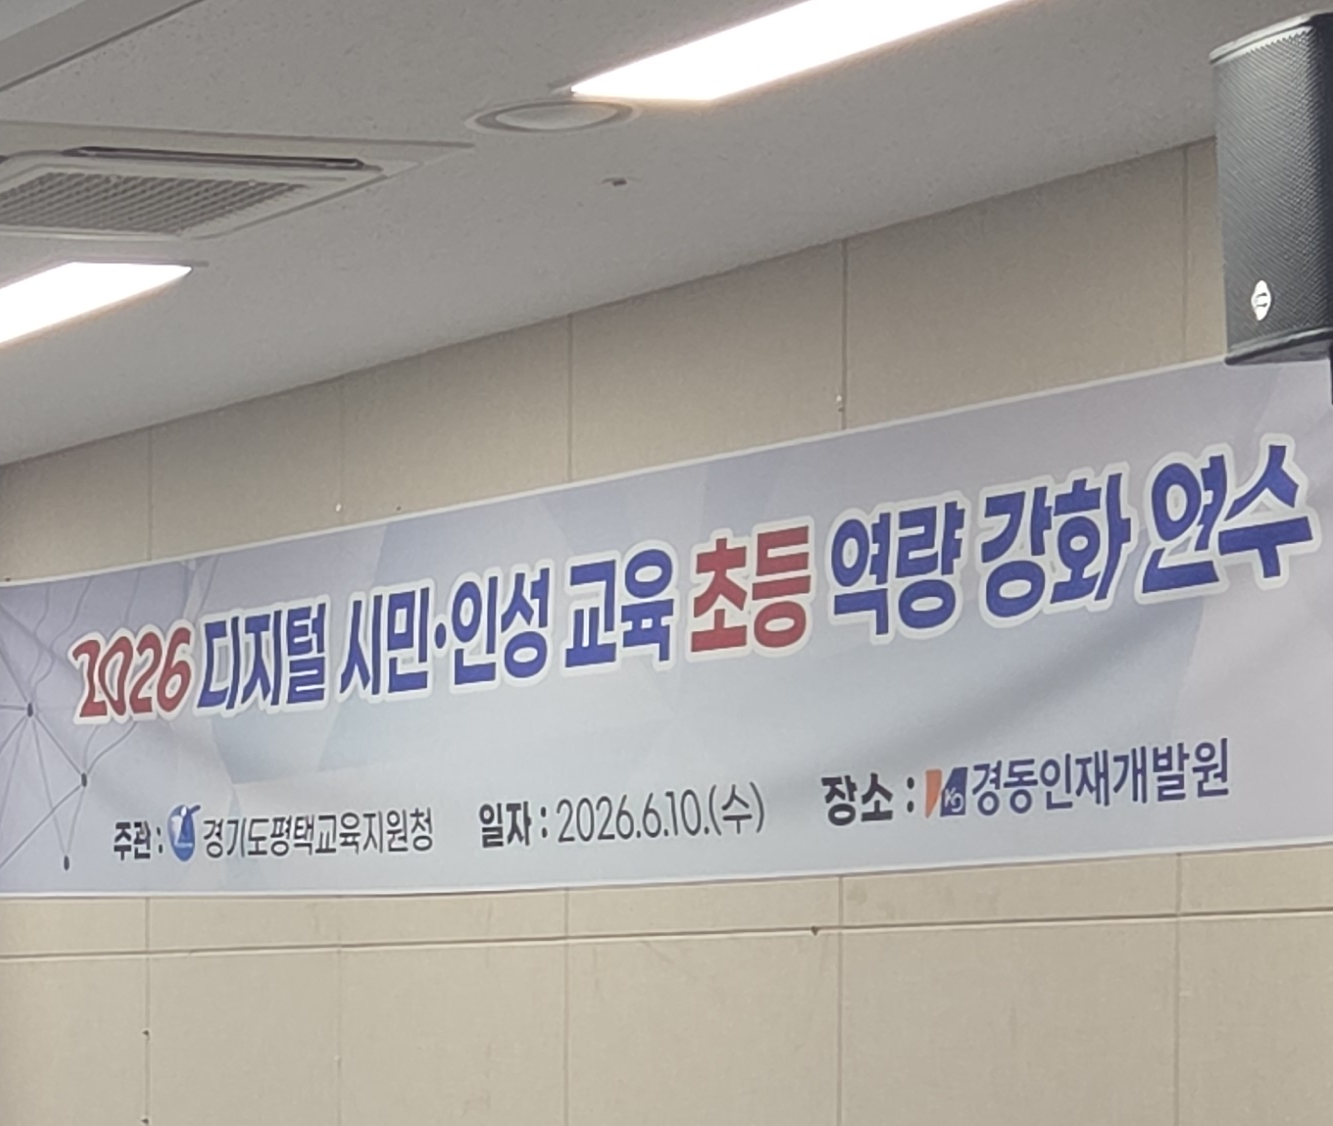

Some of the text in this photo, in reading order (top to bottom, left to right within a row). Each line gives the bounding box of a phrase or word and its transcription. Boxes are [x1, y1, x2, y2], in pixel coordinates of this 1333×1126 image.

[72, 628, 192, 717] 2026
[196, 603, 326, 709] 디지털
[564, 548, 674, 667] 교육
[690, 525, 812, 653] 초등
[831, 500, 965, 635] 역량
[981, 472, 1131, 618] 강화
[1141, 444, 1313, 595] 연수
[972, 738, 1229, 815] 경동인재개발원
[203, 807, 433, 858] 경기도평택교육지원청
[557, 782, 764, 842] 2026.6.10.(수)
